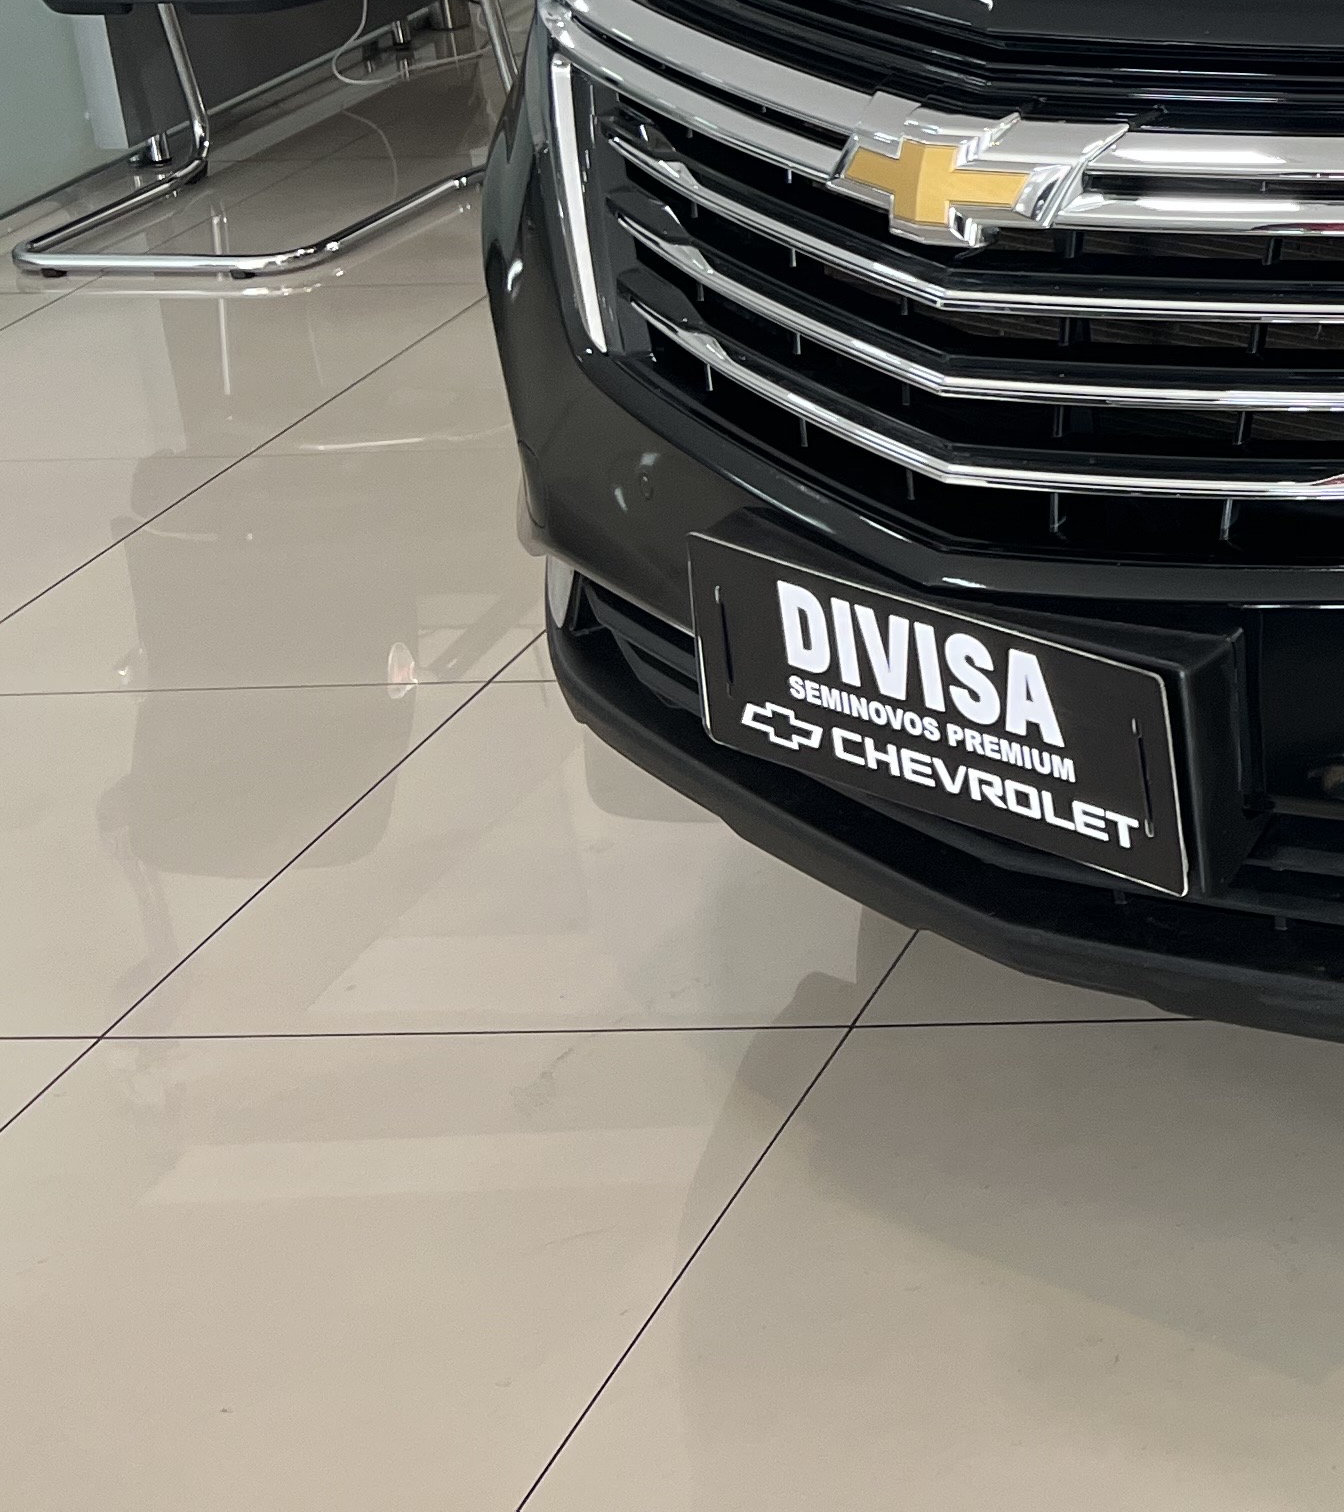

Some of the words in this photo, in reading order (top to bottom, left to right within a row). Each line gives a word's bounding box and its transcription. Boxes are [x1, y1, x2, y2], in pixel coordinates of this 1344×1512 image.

[777, 579, 1065, 748] DIVISA
[789, 674, 941, 743] SEMINOVOS
[947, 721, 1077, 783] PREMIUM
[832, 727, 1140, 849] CHEVROLET
